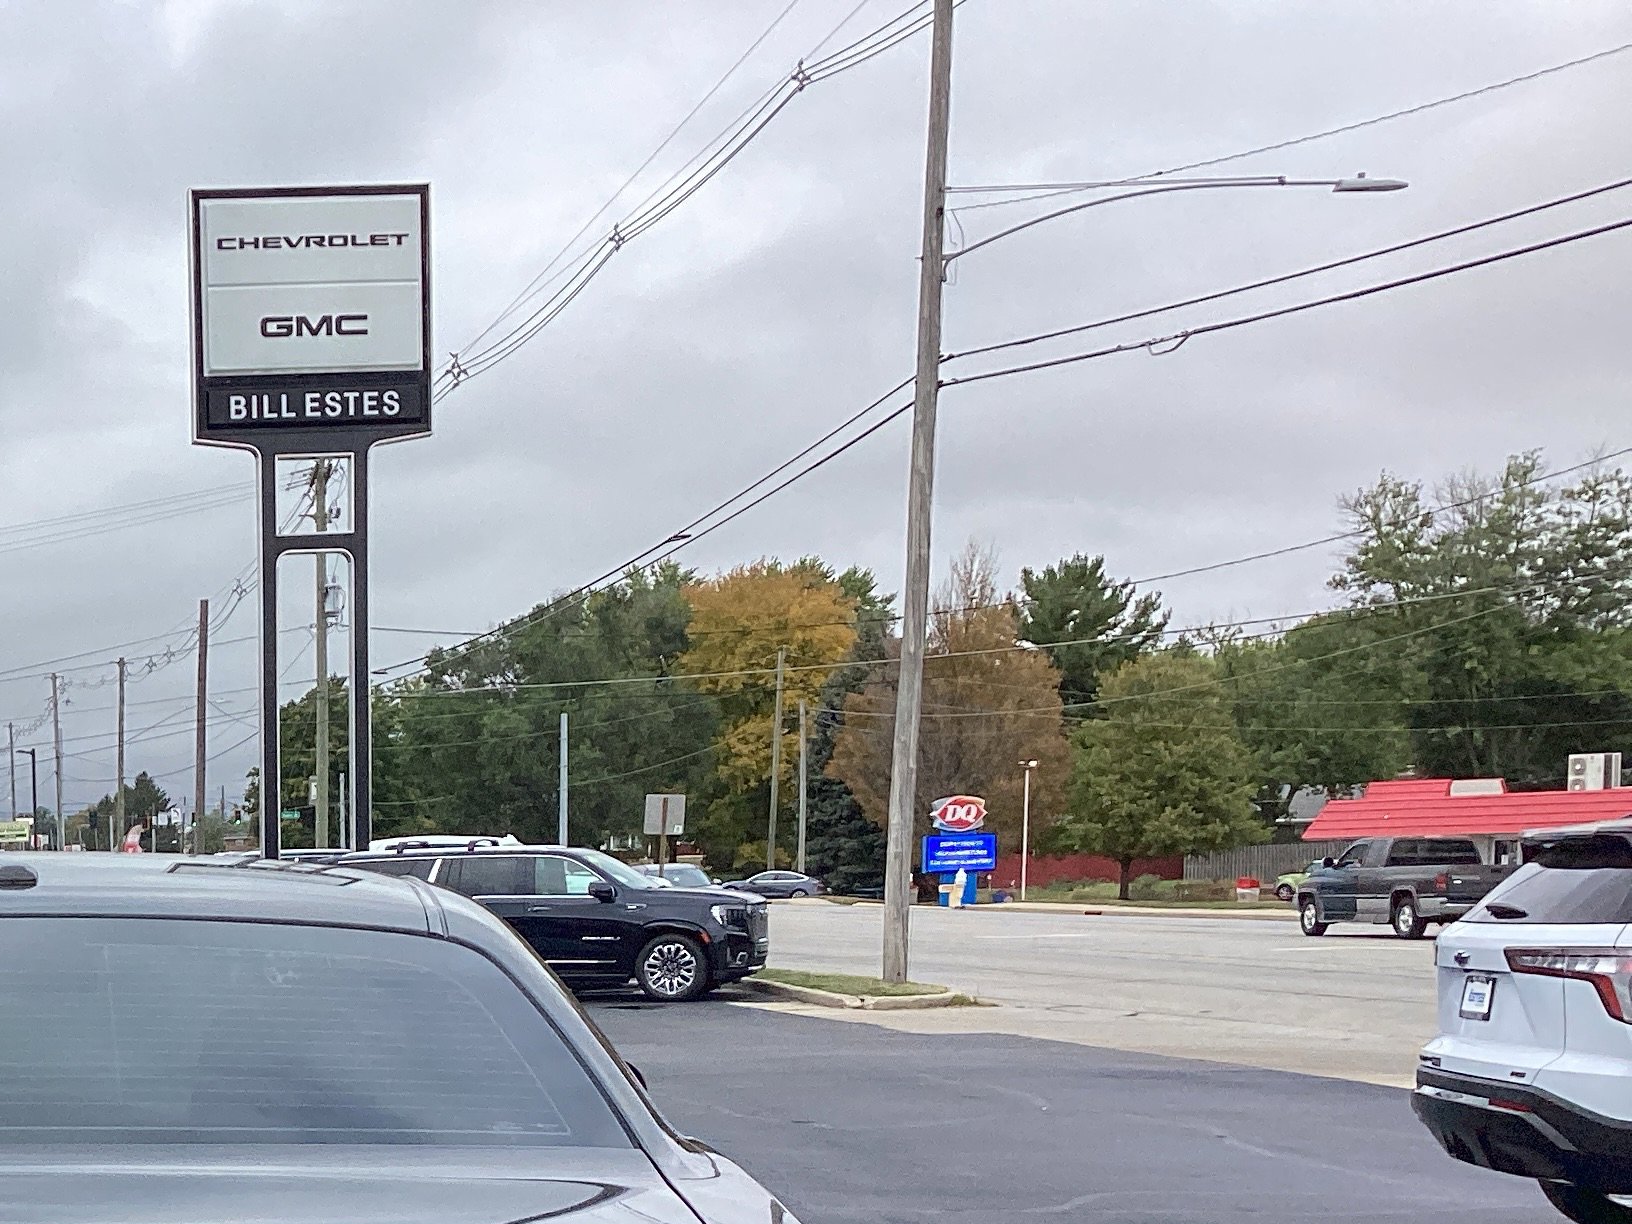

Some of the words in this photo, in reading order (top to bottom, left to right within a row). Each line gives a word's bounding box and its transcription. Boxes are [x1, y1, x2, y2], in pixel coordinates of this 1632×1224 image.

[216, 233, 410, 250] CHEVROLET
[260, 314, 369, 338] GMC
[229, 393, 296, 420] BILL
[304, 390, 401, 417] ESTES
[944, 803, 978, 823] DQ
